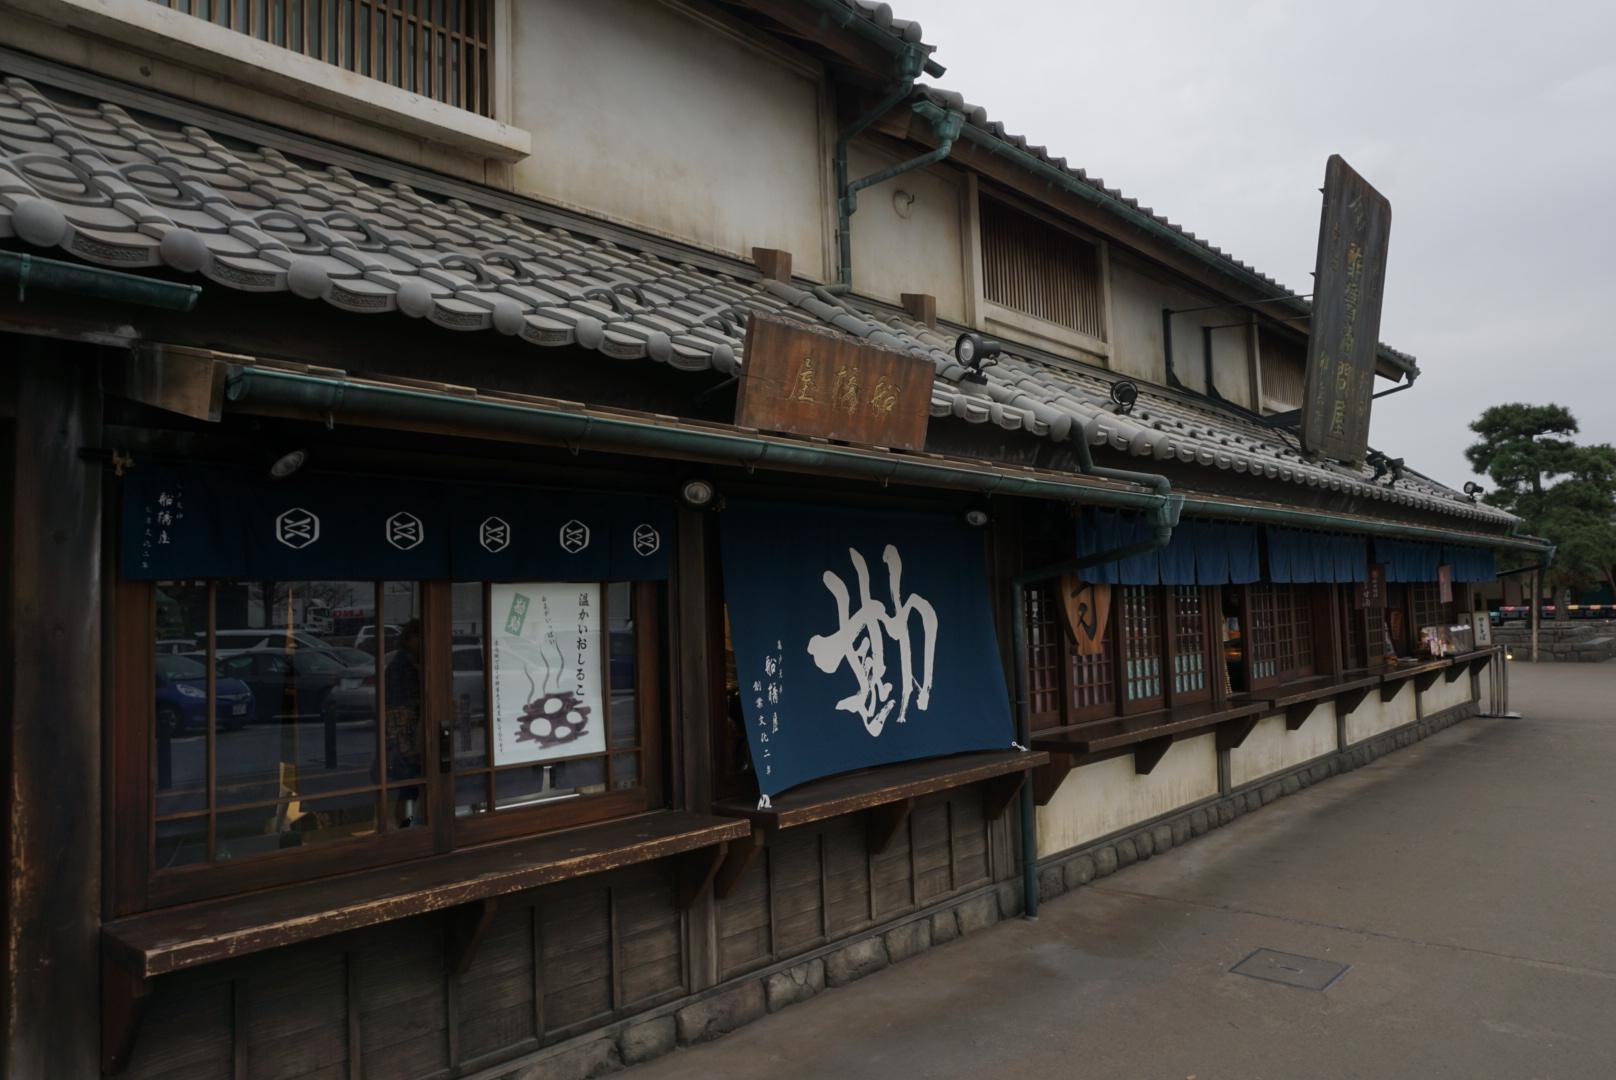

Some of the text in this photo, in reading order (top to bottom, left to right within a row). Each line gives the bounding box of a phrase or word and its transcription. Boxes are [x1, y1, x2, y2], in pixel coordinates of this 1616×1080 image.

[574, 592, 590, 697] 温かいおしるこ
[752, 680, 772, 777] 創業文化二年
[765, 655, 780, 735] 船橋屋
